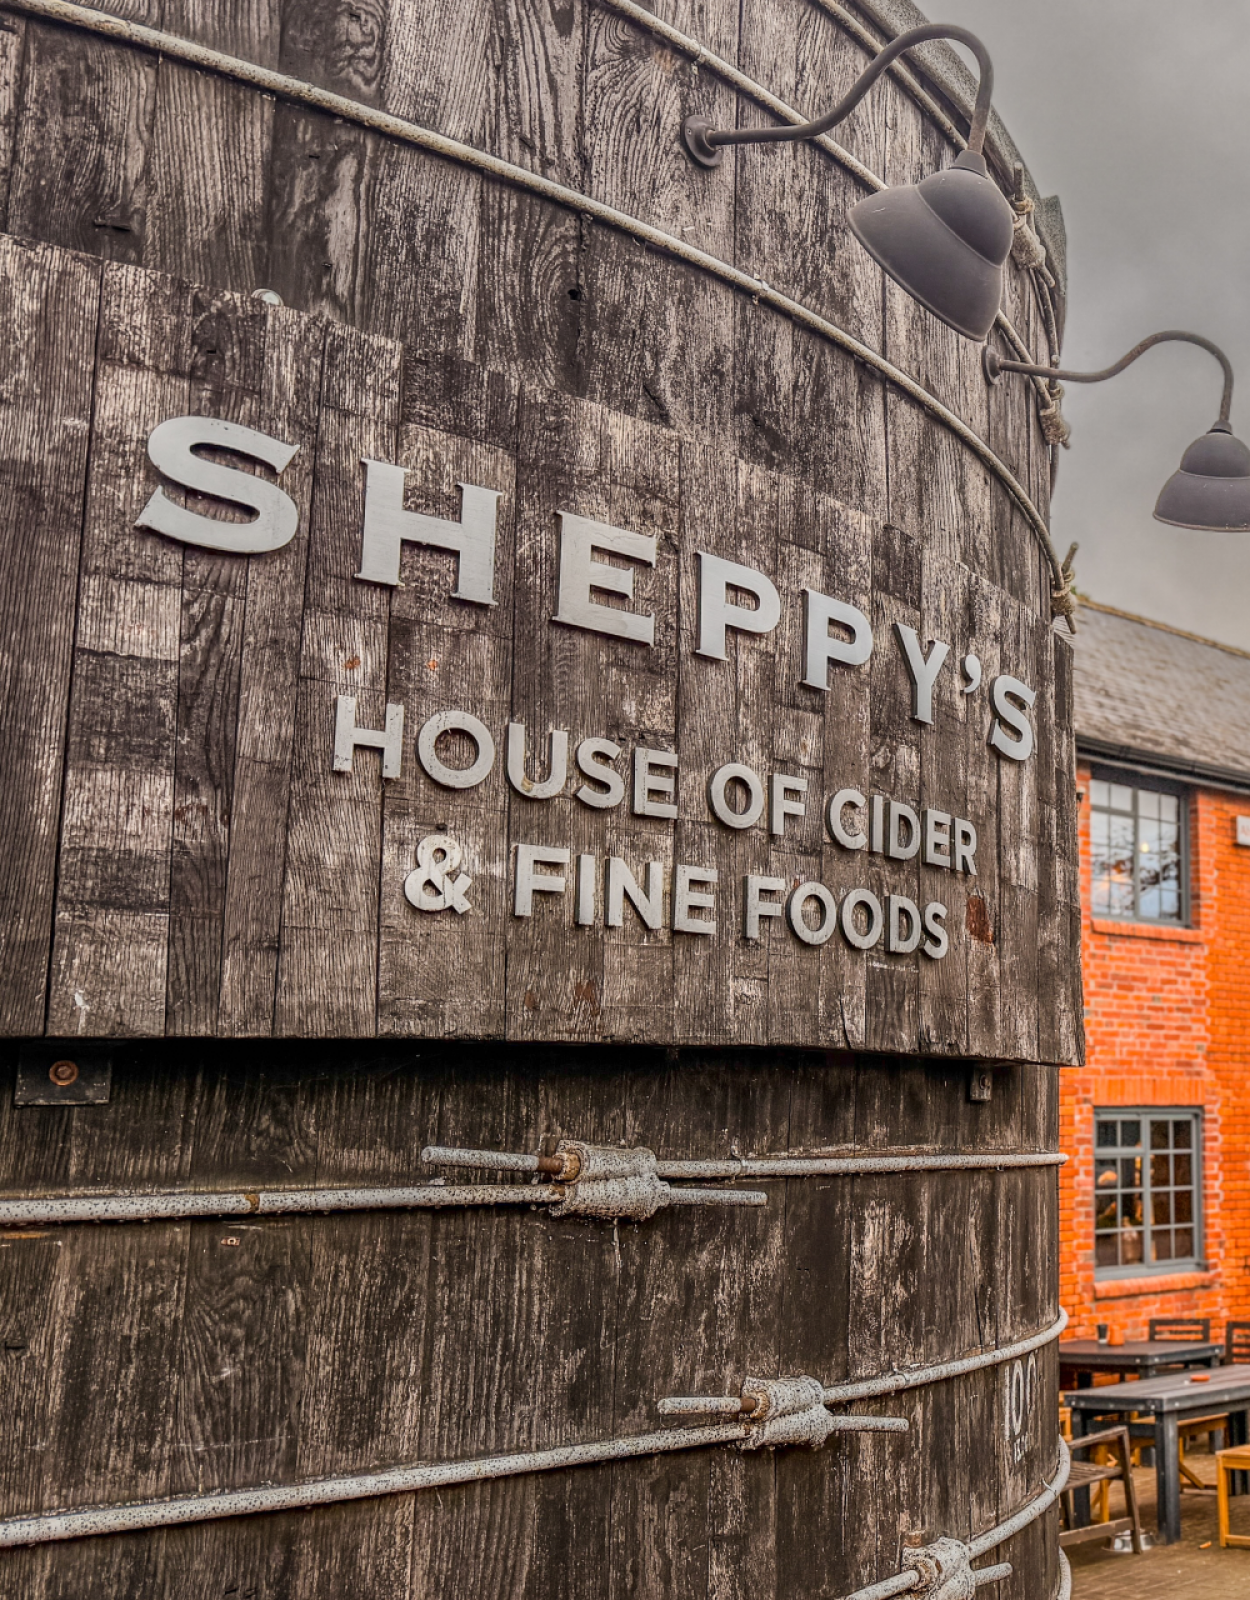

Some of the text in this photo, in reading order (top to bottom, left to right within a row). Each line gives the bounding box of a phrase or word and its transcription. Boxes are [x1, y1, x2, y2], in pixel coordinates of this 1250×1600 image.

[134, 416, 1037, 761] SHEPPY'S
[333, 695, 977, 876] HOUSE OF CIDER
[404, 834, 948, 959] & FINE FOODS
